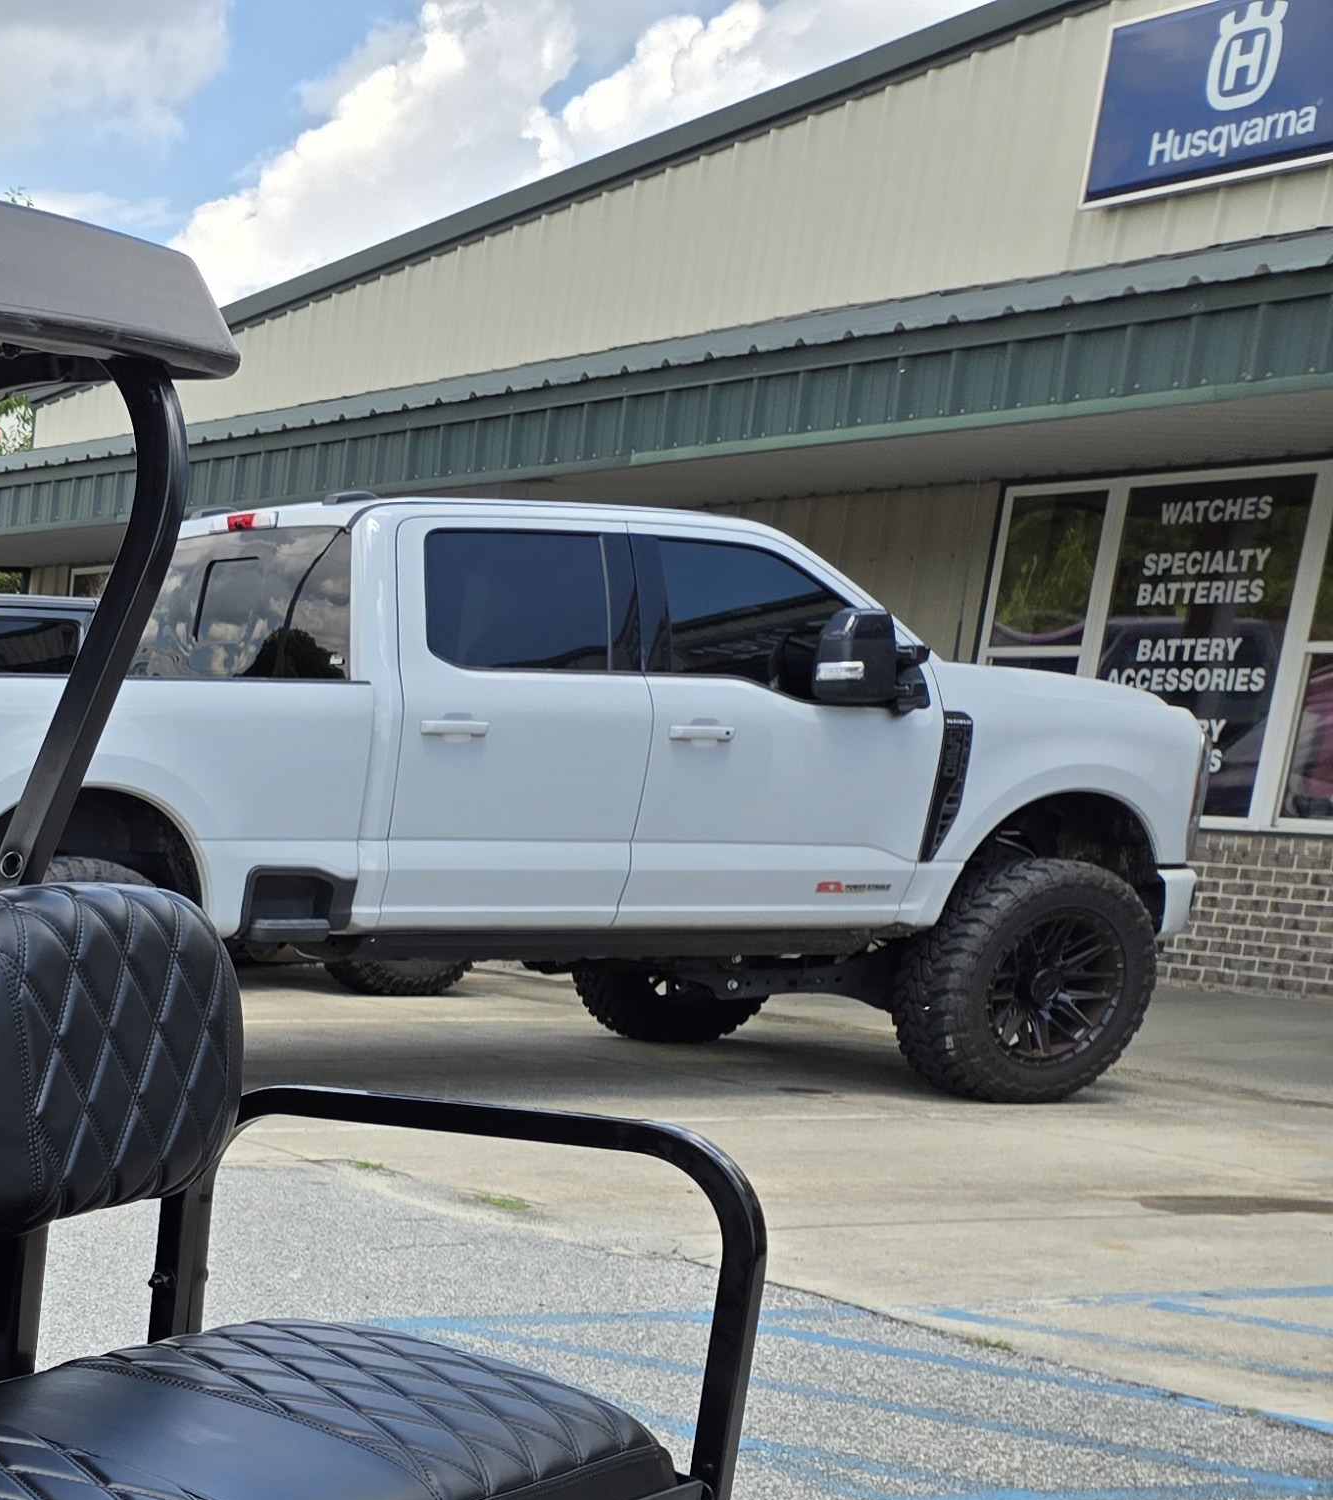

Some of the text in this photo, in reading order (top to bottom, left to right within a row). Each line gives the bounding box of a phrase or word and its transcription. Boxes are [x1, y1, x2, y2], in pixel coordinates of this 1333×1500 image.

[1147, 105, 1317, 167] Husqvarna
[1161, 495, 1273, 525] WATCHES
[1142, 547, 1271, 577] SPECIALTY
[1137, 579, 1264, 606] BATTERIES
[1136, 637, 1242, 662] BATTERY
[1106, 668, 1266, 692] ACCESSORIES
